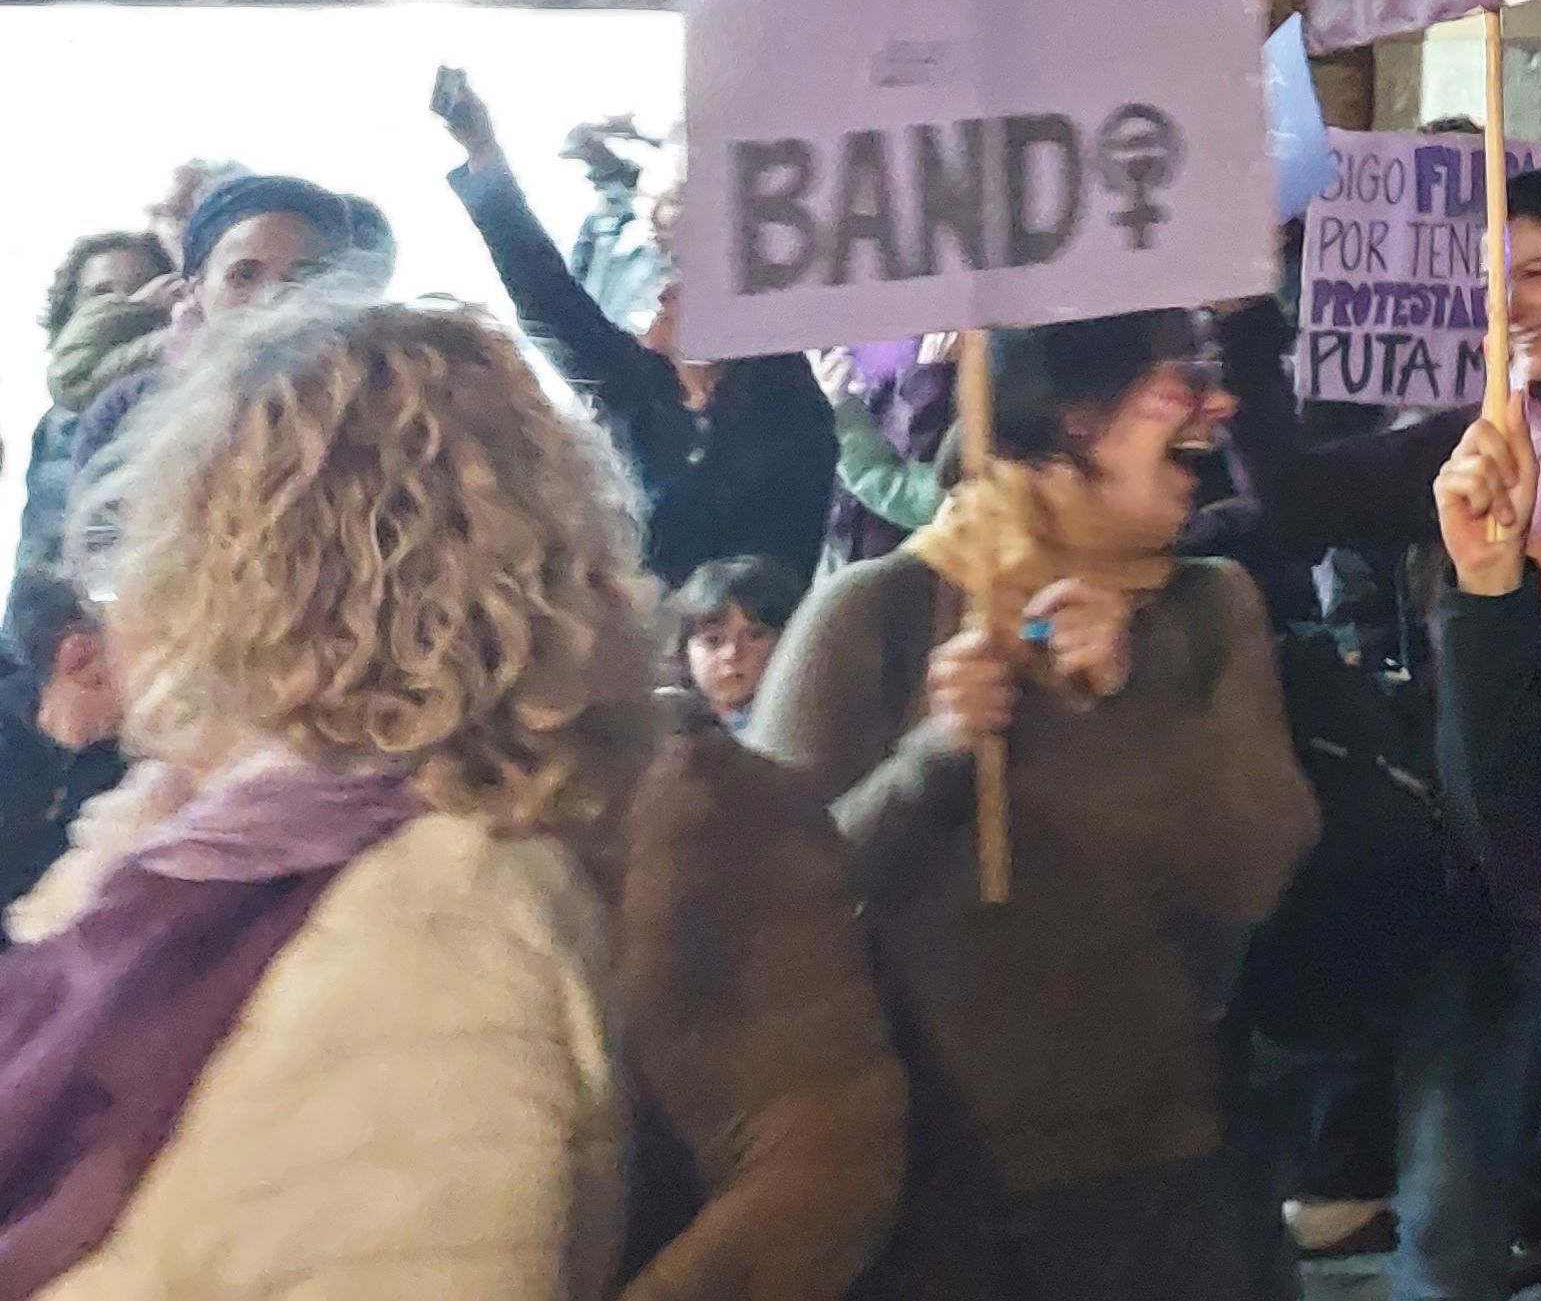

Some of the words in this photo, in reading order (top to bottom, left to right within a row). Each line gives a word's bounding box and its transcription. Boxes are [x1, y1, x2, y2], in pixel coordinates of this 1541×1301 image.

[1319, 148, 1406, 206] SIGO
[1318, 216, 1391, 273] POR
[1308, 330, 1443, 399] PUTA
